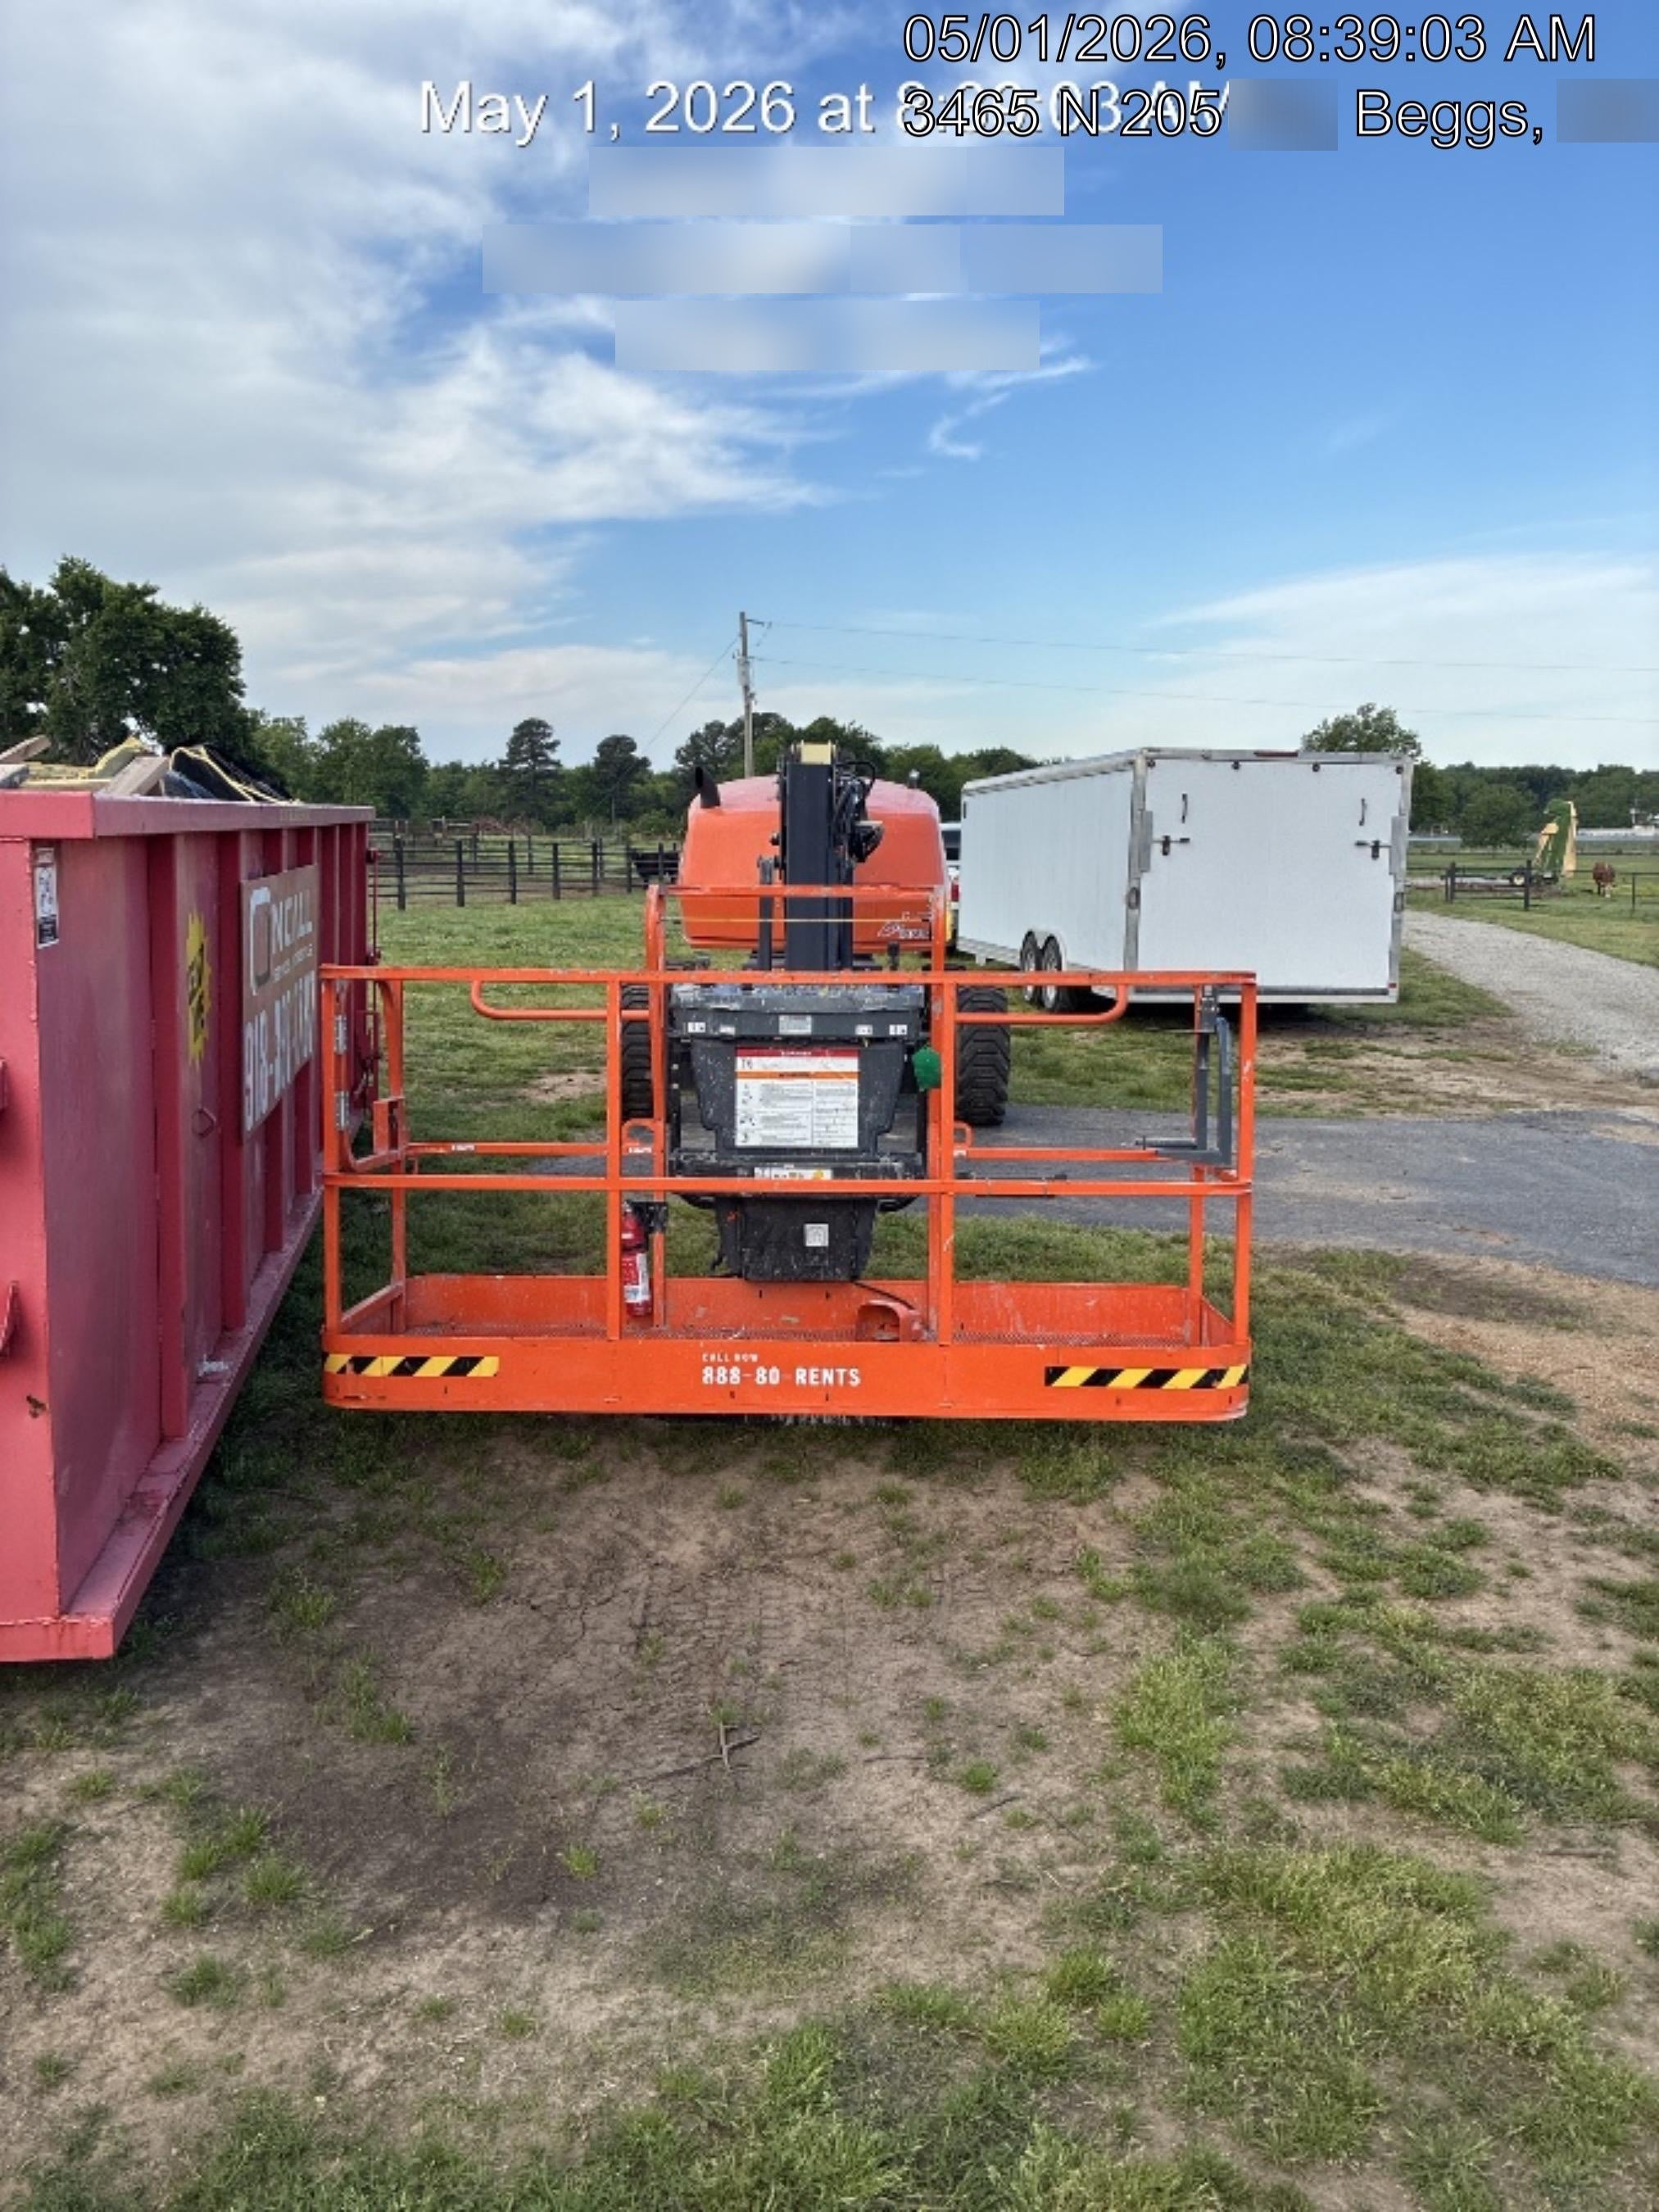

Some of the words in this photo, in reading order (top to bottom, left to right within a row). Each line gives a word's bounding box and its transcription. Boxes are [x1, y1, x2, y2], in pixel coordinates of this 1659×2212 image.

[701, 1353, 730, 1362] CALL
[733, 1353, 759, 1362] NOW
[795, 1367, 861, 1386] RENTS
